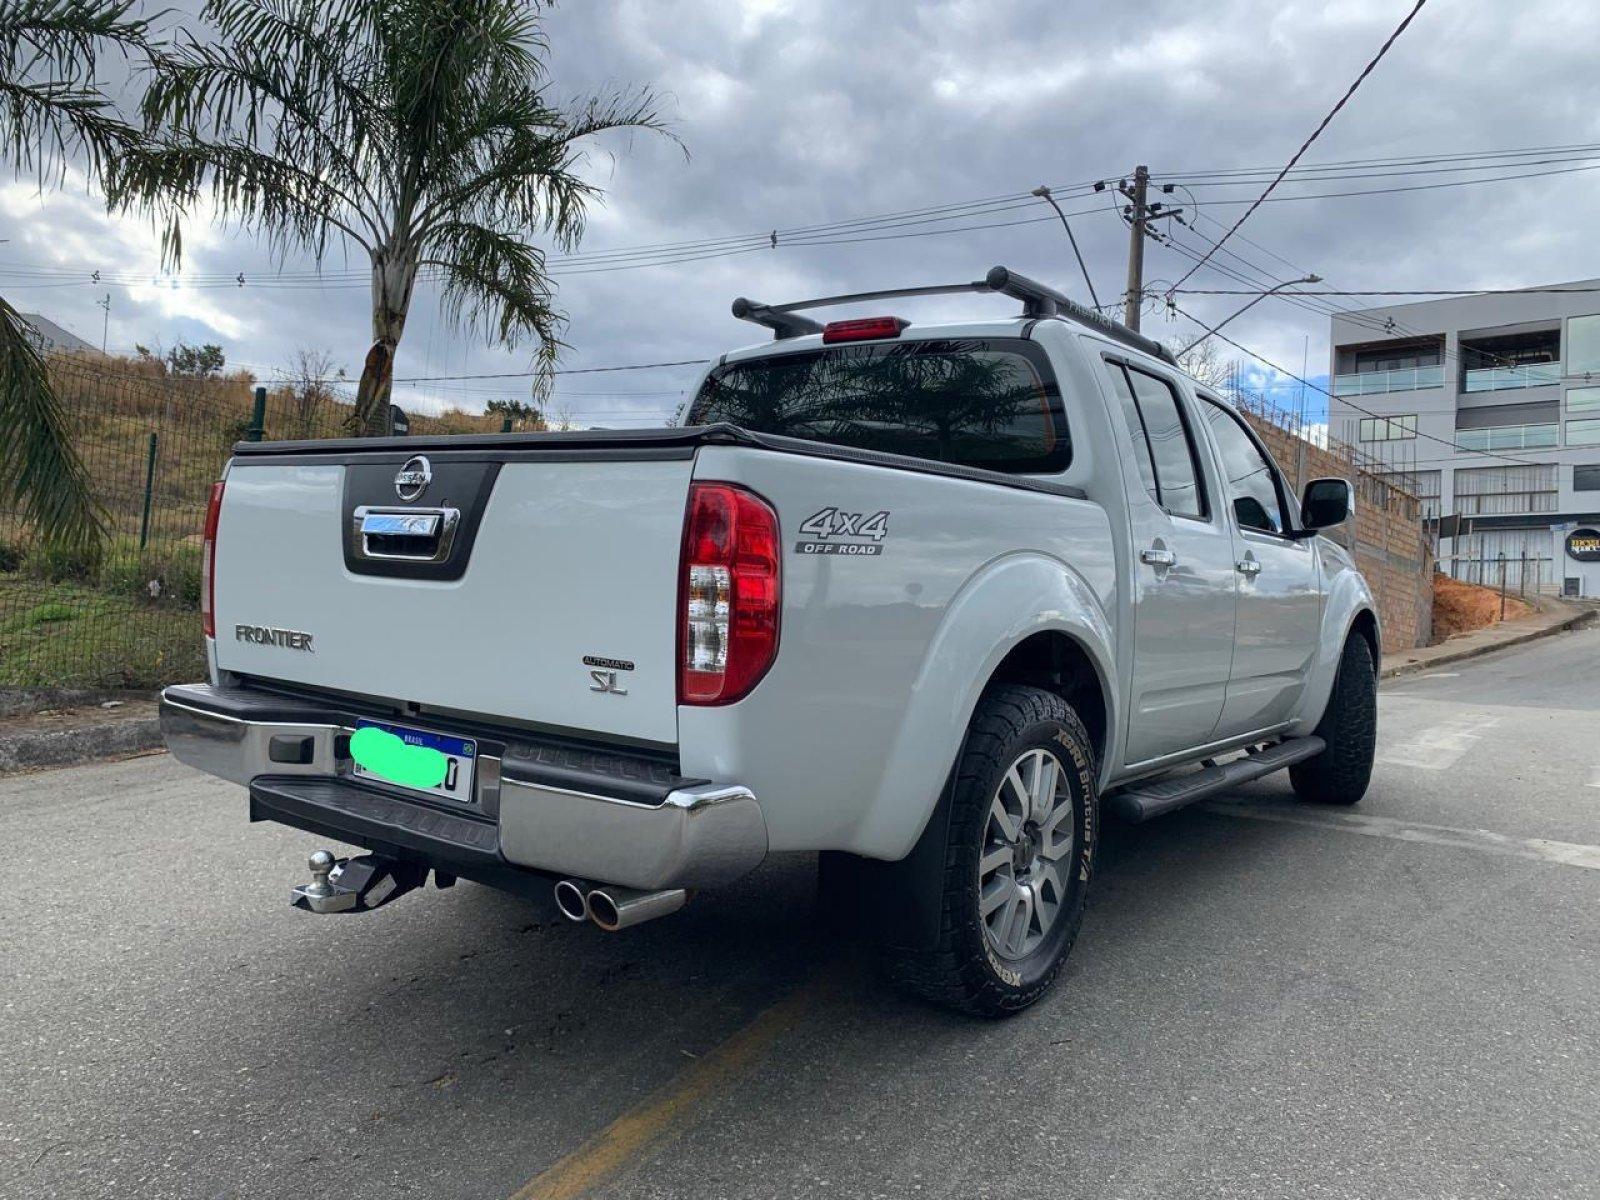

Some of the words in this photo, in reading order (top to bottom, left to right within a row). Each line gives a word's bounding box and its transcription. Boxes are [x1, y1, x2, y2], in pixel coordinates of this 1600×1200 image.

[799, 507, 890, 541] 4x4
[804, 543, 834, 554] OFF
[838, 545, 876, 555] ROAD
[235, 623, 315, 653] FRONTIER
[583, 656, 634, 670] AUTOMATIC
[590, 669, 628, 696] SL
[404, 734, 424, 746] BRASIL
